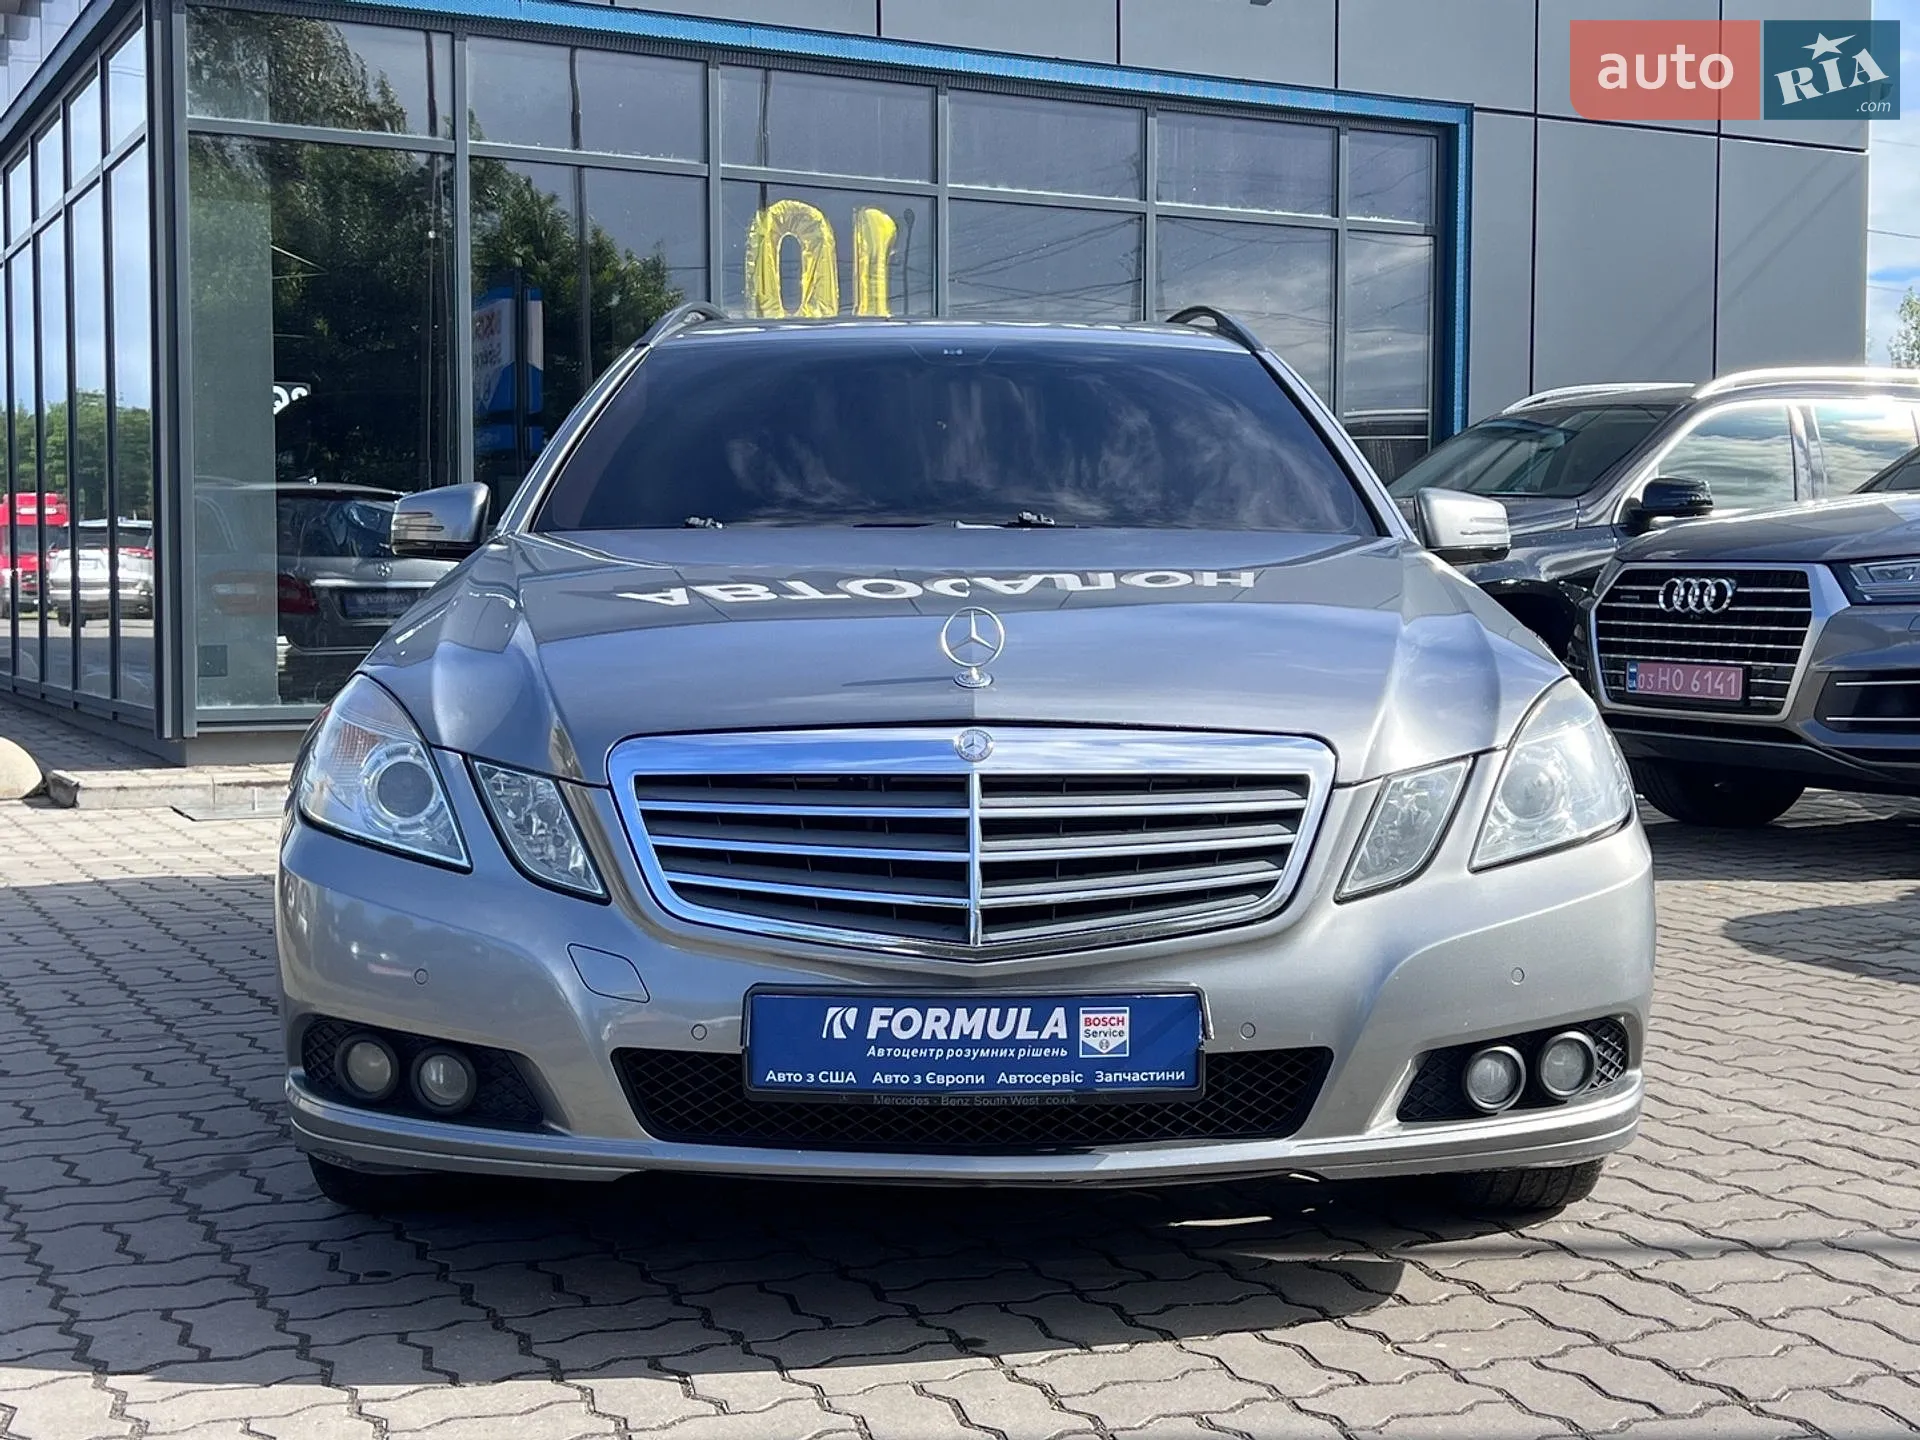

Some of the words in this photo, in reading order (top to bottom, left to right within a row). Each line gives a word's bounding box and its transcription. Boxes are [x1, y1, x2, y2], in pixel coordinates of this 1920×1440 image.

[1691, 669, 1736, 696] 6141
[866, 1007, 1067, 1040] FORMULA
[1084, 1016, 1125, 1027] BOSCH
[1084, 1029, 1125, 1039] Service
[866, 1045, 944, 1060] Автоцентр
[946, 1048, 1015, 1060] розумних
[1017, 1044, 1068, 1060] рішень
[765, 1070, 803, 1083] Авто
[806, 1073, 815, 1083] з
[818, 1070, 857, 1084] США
[872, 1071, 910, 1085] Авто
[913, 1074, 922, 1084] з
[925, 1072, 985, 1087] Європи
[997, 1071, 1084, 1085] Автосервіс
[1095, 1069, 1186, 1084] Запчастини
